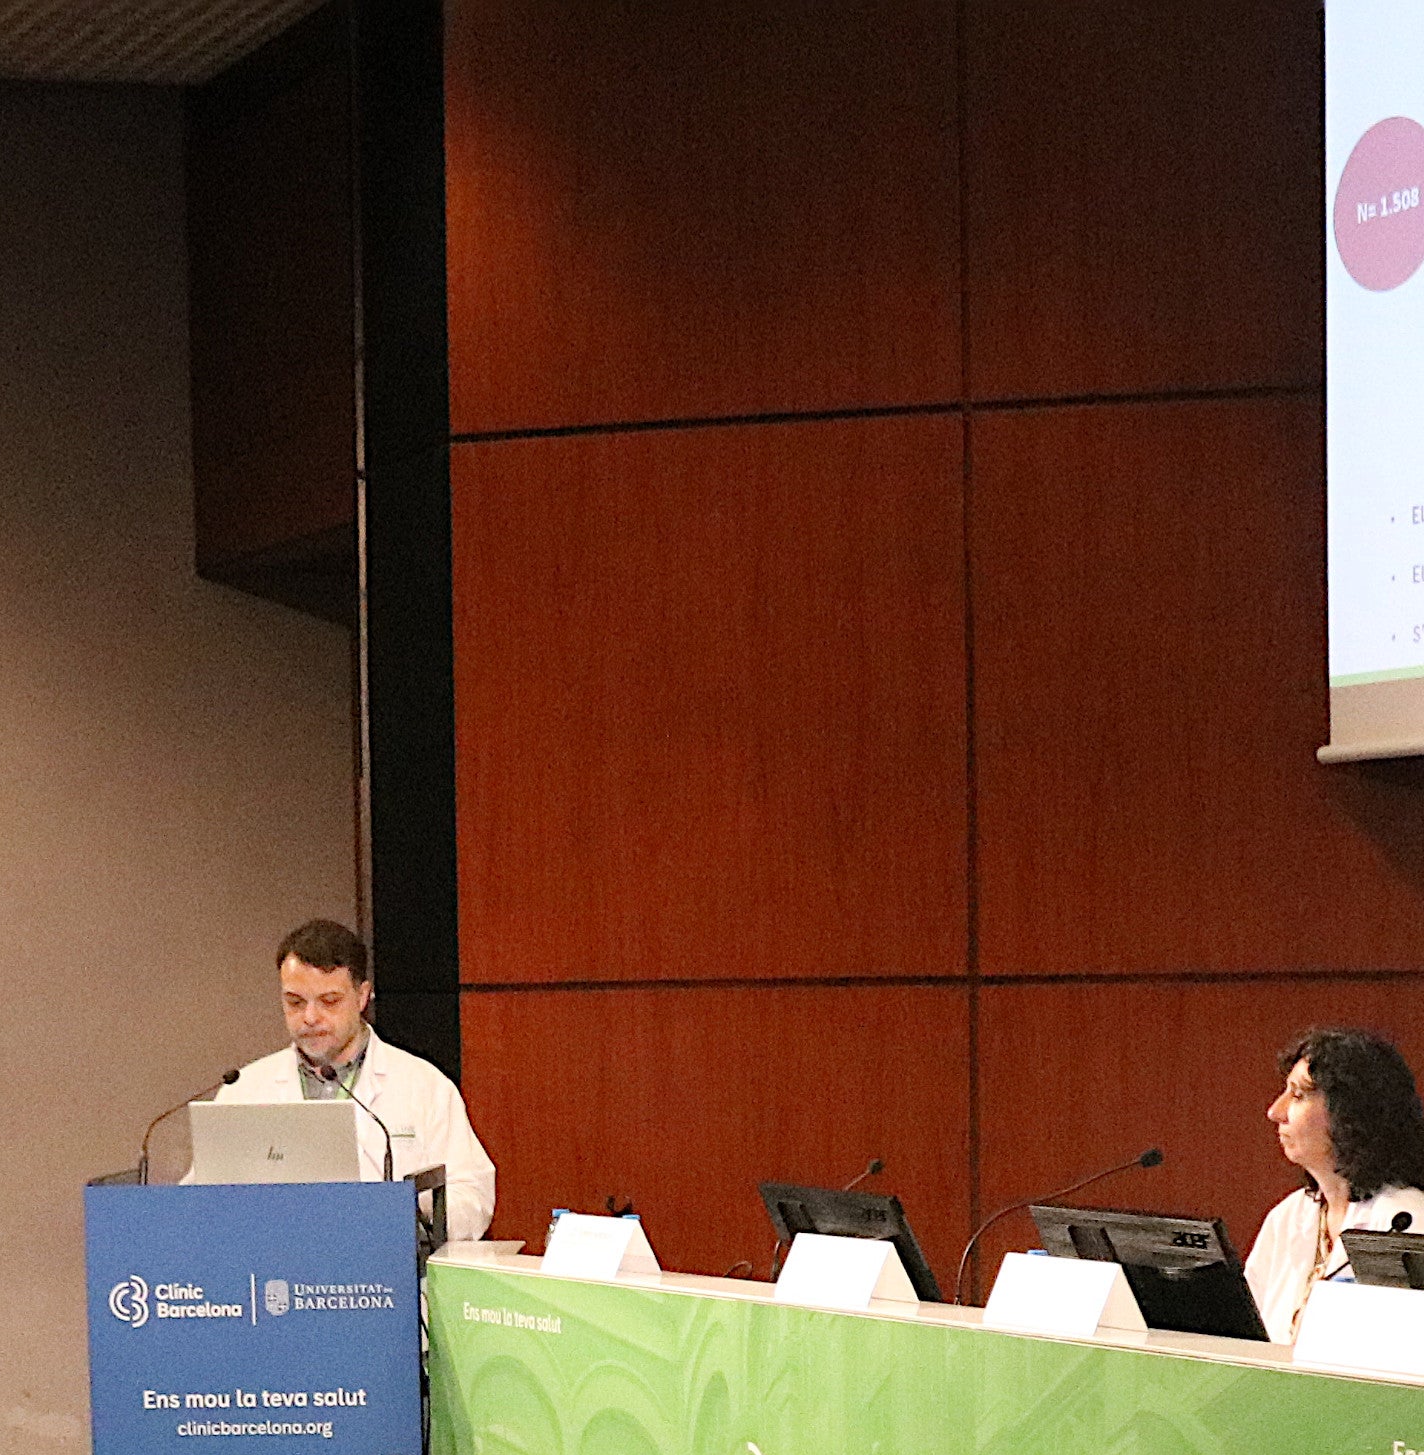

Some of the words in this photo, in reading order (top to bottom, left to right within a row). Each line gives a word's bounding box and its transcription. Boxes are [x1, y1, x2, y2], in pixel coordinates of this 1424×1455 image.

[1357, 203, 1376, 224] N=
[1380, 187, 1419, 216] 1.508
[155, 1283, 204, 1300] Clínic
[294, 1283, 382, 1295] UNIVERSITAT
[157, 1302, 242, 1318] Barcelona
[295, 1296, 394, 1310] BARCELONA
[463, 1301, 480, 1321] Ens
[481, 1308, 501, 1324] mou
[503, 1308, 513, 1326] la
[514, 1311, 535, 1329] teva
[537, 1315, 561, 1334] salut
[143, 1390, 180, 1409] Ens
[186, 1393, 230, 1408] mou
[236, 1389, 256, 1408] la
[262, 1390, 308, 1408] teva
[313, 1388, 367, 1408] salut
[178, 1421, 333, 1438] clinicbarcelona.org
